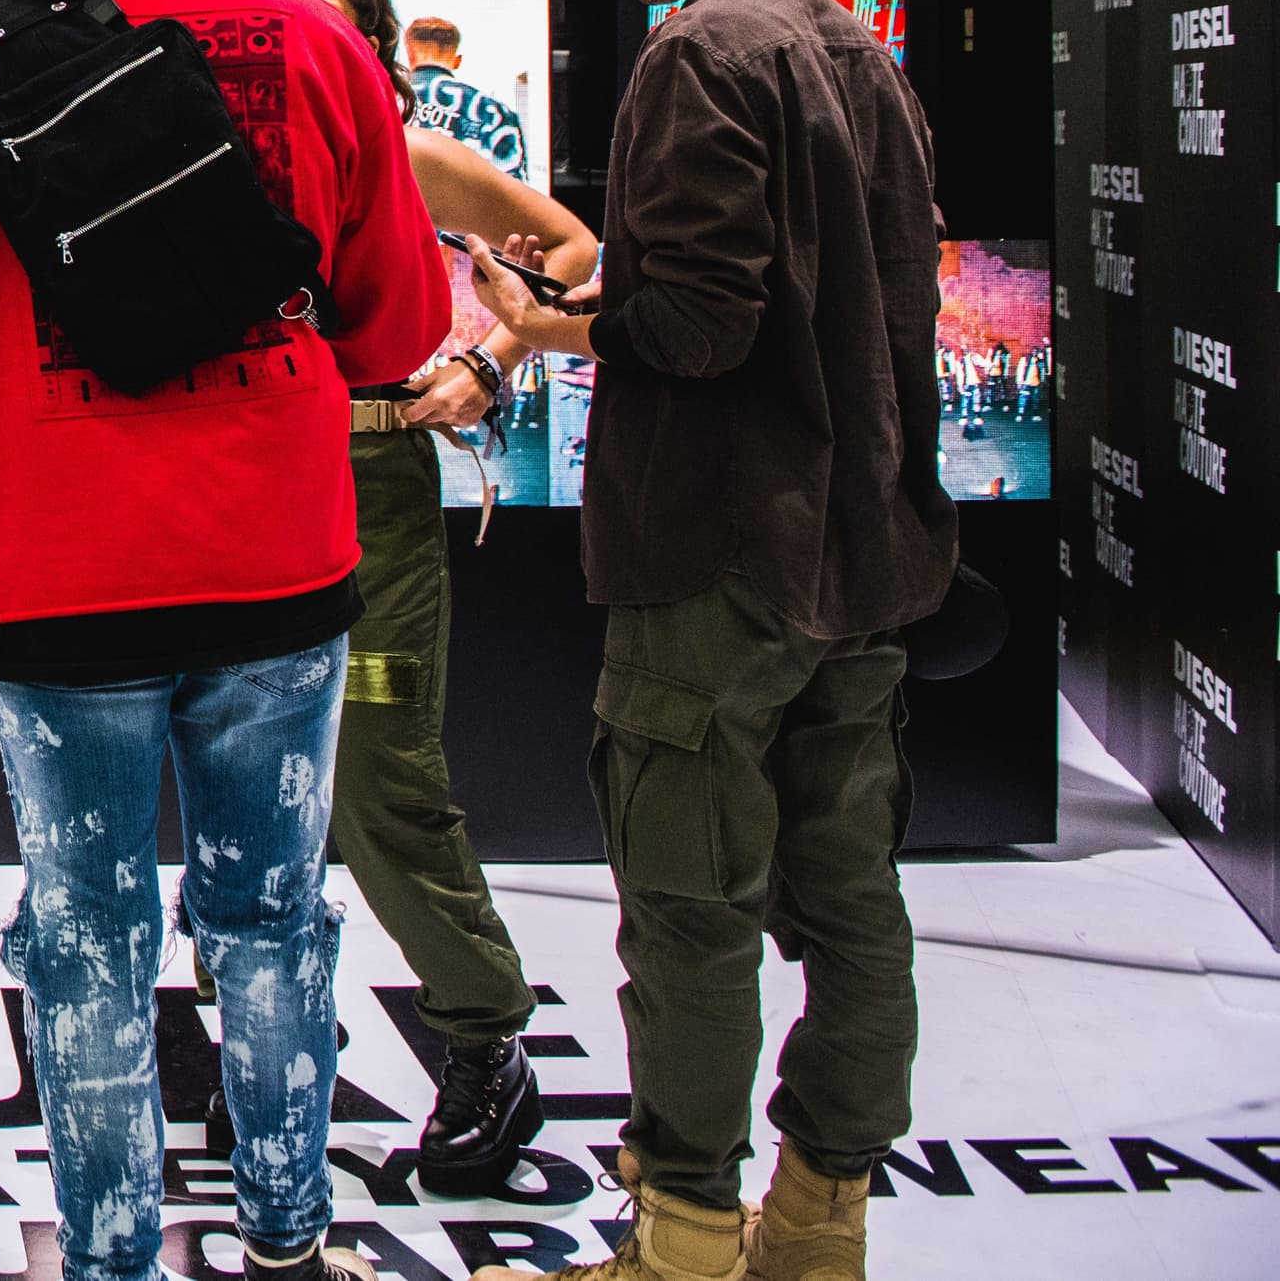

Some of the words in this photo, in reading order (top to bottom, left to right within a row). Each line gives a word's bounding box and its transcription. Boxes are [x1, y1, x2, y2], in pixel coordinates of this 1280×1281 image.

[1172, 5, 1236, 51] DIESEL
[1178, 110, 1225, 157] COUTURE
[1091, 164, 1144, 203] DIESEL
[1174, 326, 1237, 389] DIESEL
[1091, 435, 1144, 498] DIESEL
[1180, 427, 1227, 494] COUTURE
[1174, 639, 1237, 734] DIESEL
[1179, 745, 1226, 833] COUTURE
